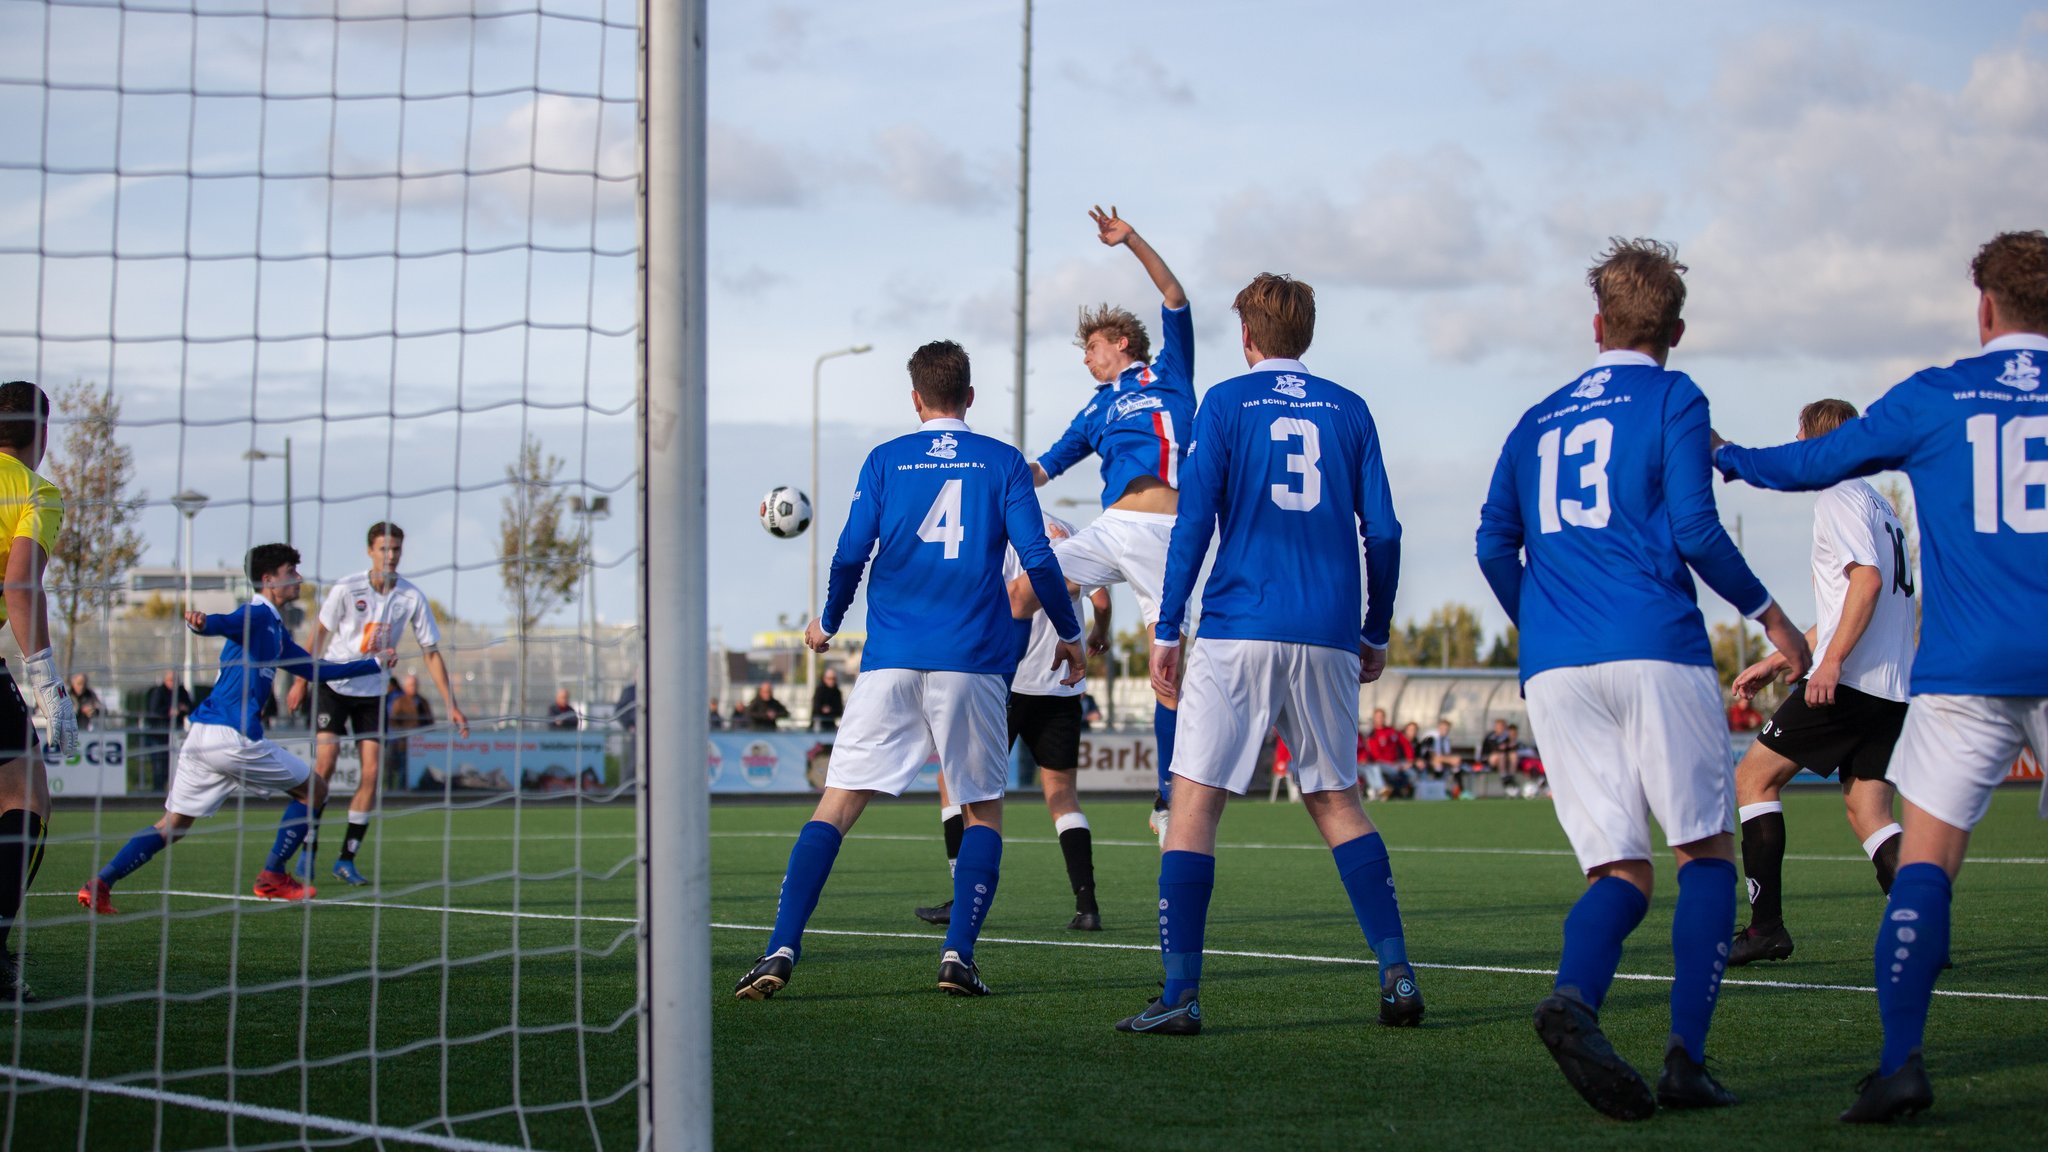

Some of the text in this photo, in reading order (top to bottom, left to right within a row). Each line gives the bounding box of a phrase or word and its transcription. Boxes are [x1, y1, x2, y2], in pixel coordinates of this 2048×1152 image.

[1129, 400, 1154, 411] BUTCHER
[1242, 400, 1260, 408] VAN
[1262, 398, 1287, 406] SCHIP
[1325, 402, 1340, 411] B.V.
[1553, 404, 1579, 418] SCHIP
[1580, 398, 1613, 412] ALPHEN
[1953, 391, 1976, 400] VAN
[1979, 391, 2013, 401] SCHIP
[1270, 416, 1321, 512] 3
[1537, 418, 1614, 534] 13
[1966, 413, 2048, 534] 16
[916, 479, 965, 560] 4
[1884, 521, 1915, 598] 10
[1078, 740, 1157, 771] Bark
